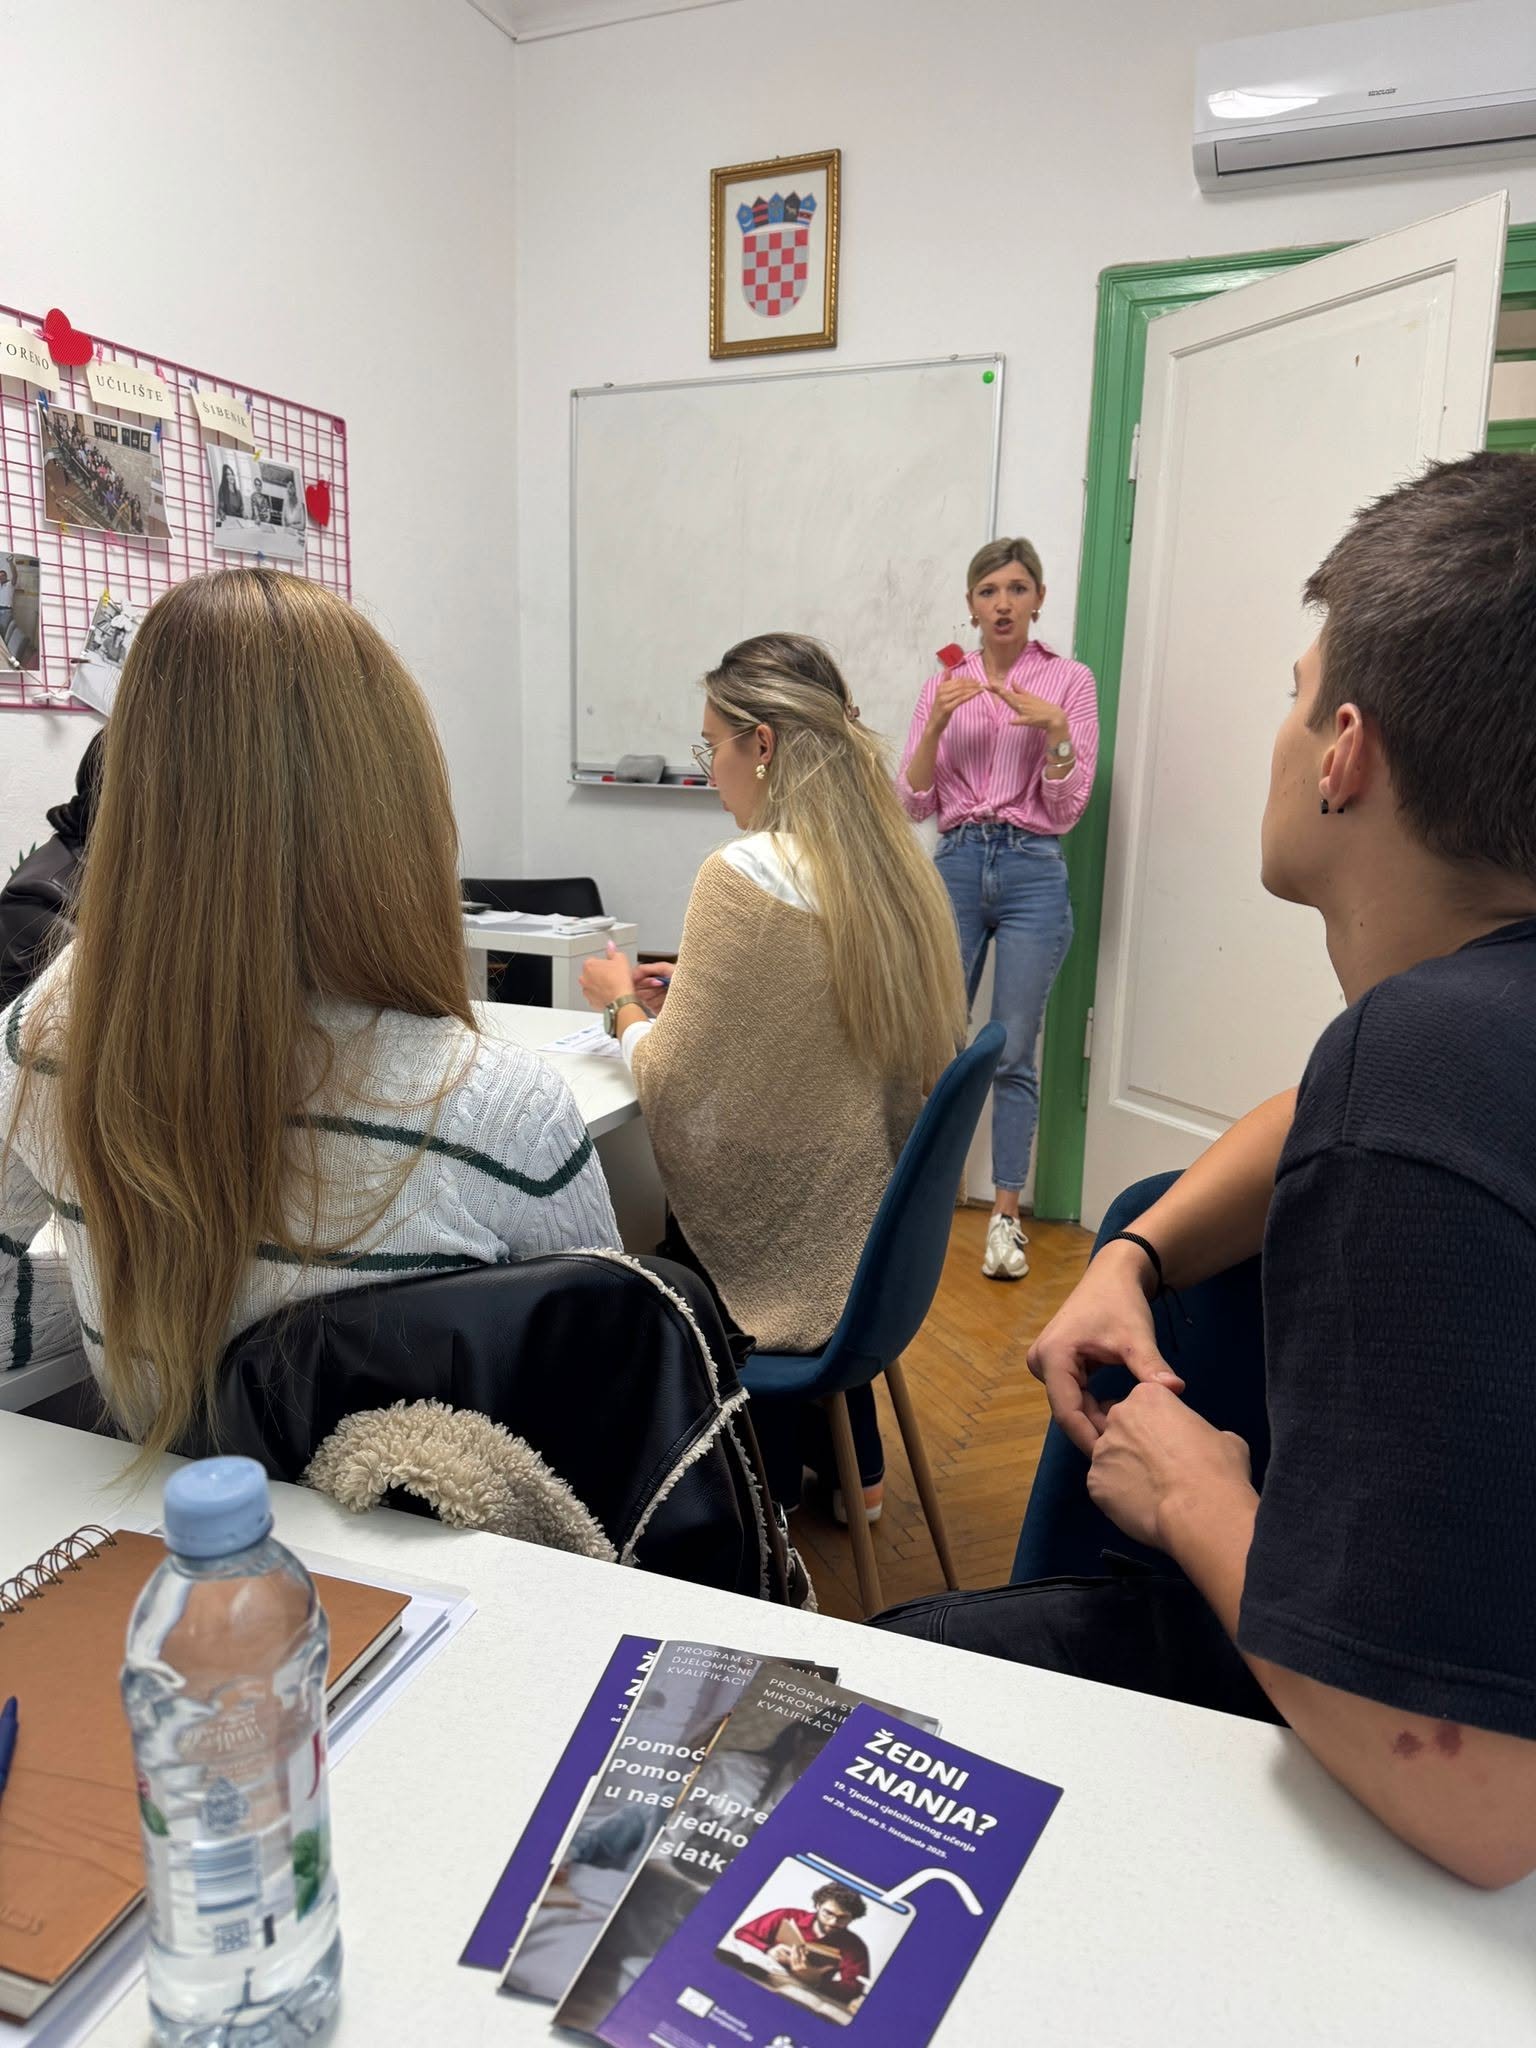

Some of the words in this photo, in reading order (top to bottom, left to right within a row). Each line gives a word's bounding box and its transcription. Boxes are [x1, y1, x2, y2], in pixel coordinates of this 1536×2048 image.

[0, 341, 50, 370] ORENO
[95, 375, 164, 402] UČILIŠTE
[671, 1655, 753, 1678] DJELOMIČNE
[676, 1645, 742, 1663] PROGRAM
[769, 1678, 837, 1707] PROGRAM
[620, 1736, 706, 1762] Pomoć
[864, 1728, 970, 1792] ŽEDNI
[604, 1785, 622, 1799] u
[627, 1788, 676, 1809] nas
[844, 1756, 998, 1836] ZNANJA?
[822, 1794, 834, 1804] od
[868, 1817, 880, 1827] do
[888, 1826, 926, 1849] listopada
[833, 1780, 847, 1792] 19.
[848, 1787, 880, 1808] Tjedan
[880, 1804, 943, 1839] cjeloživotnog
[943, 1832, 977, 1853] učenja
